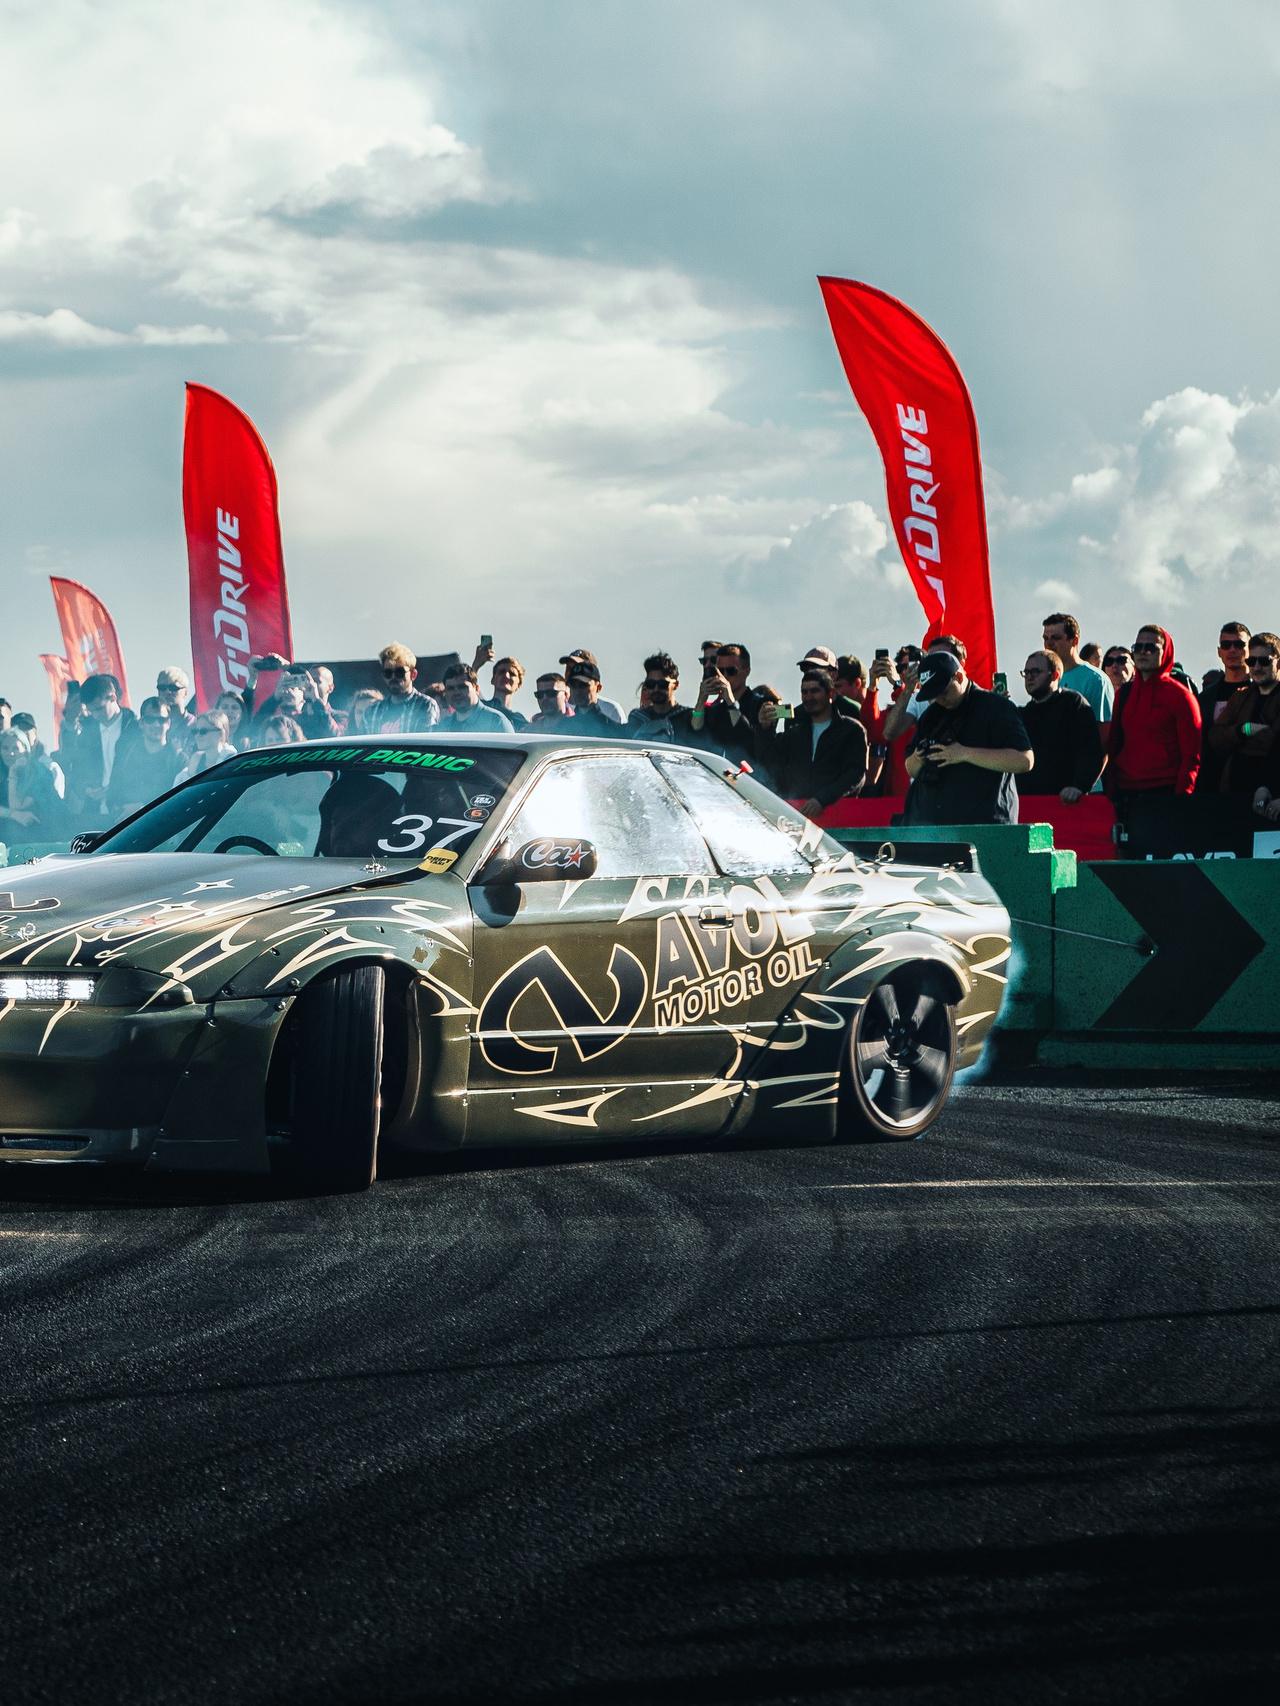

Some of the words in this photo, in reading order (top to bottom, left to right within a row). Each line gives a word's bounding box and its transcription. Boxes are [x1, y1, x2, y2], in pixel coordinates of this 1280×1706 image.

[233, 749, 363, 772] TSUNAMI
[363, 749, 476, 772] PICNIC
[377, 814, 484, 853] 37
[426, 855, 453, 864] DRIFT
[652, 875, 816, 1000] AVOL
[655, 962, 763, 1034] MOTOR
[767, 942, 822, 987] OIL
